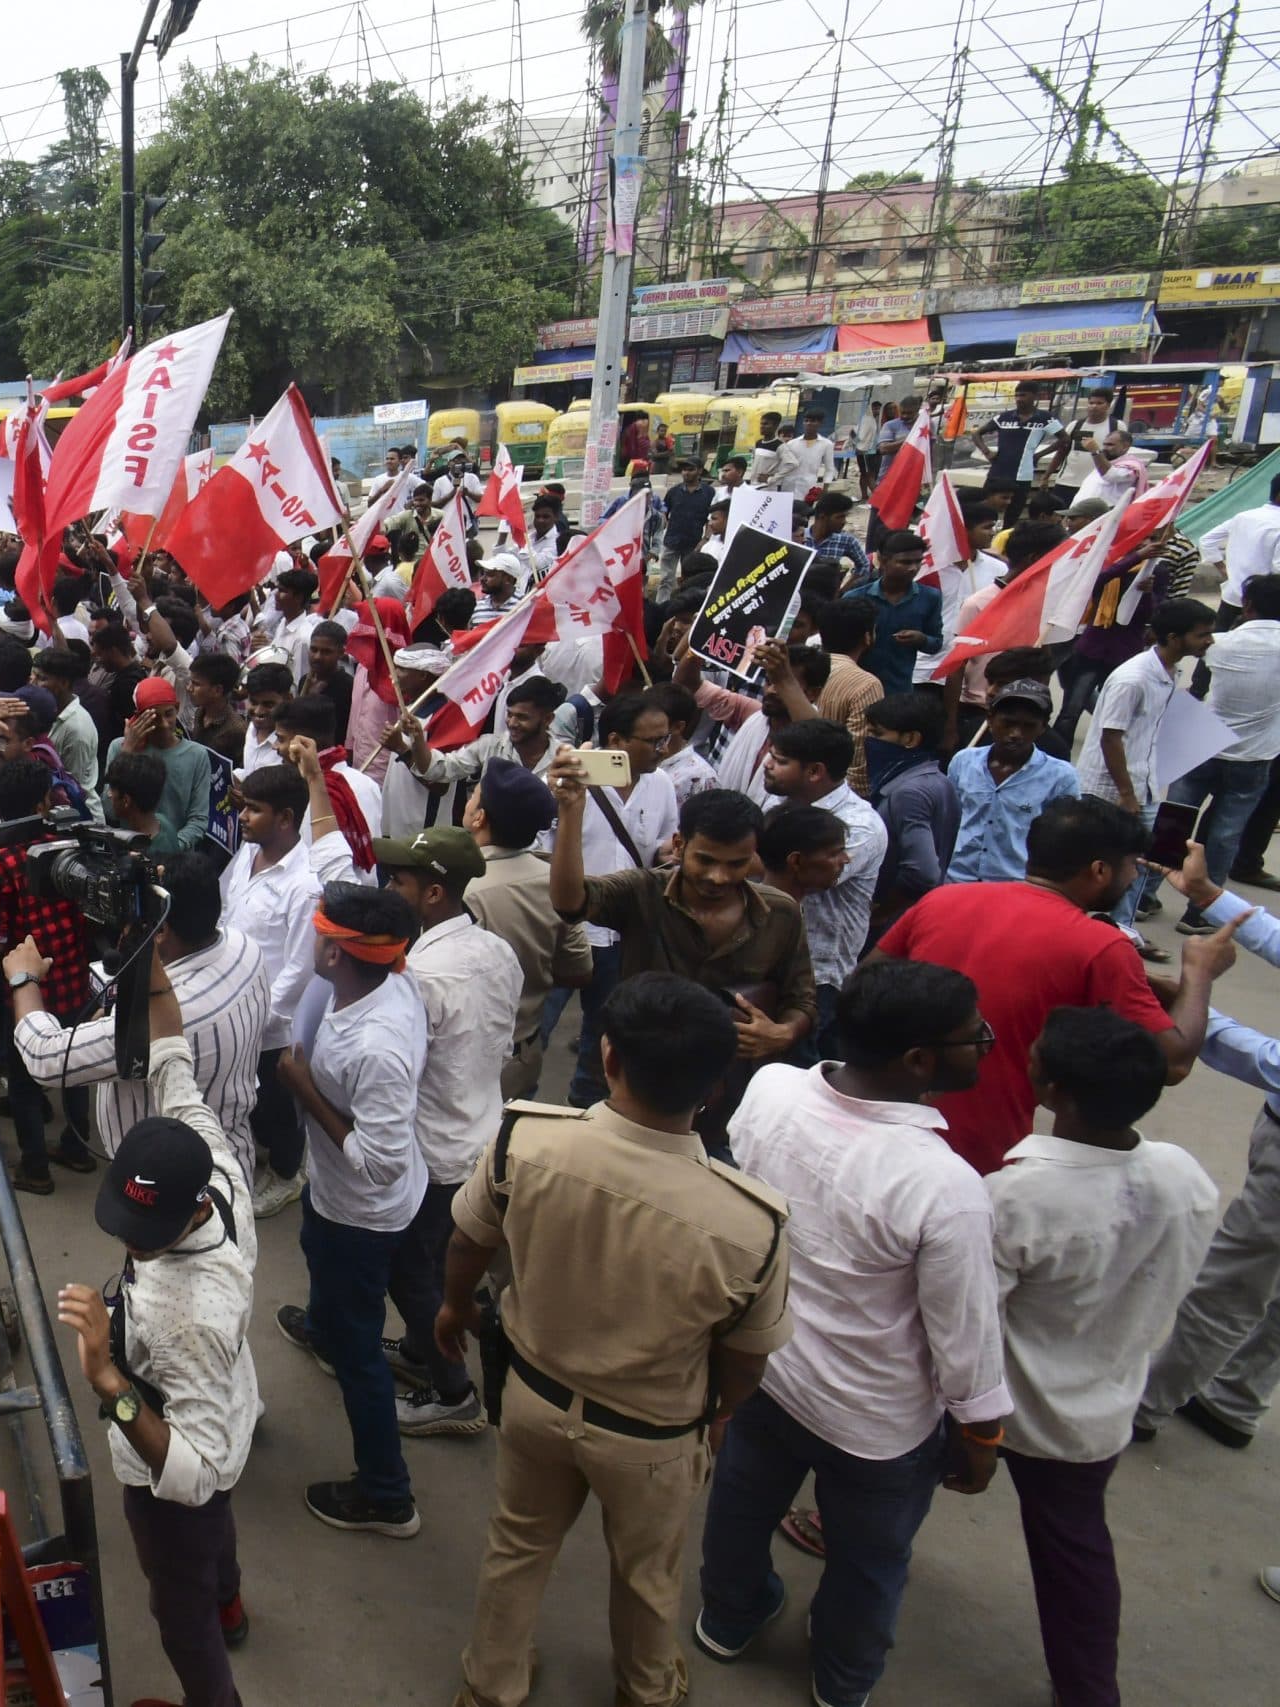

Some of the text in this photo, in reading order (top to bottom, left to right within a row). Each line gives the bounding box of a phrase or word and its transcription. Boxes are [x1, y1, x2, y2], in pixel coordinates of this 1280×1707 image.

[1213, 271, 1259, 284] MAK
[705, 603, 718, 618] KG
[725, 587, 737, 601] PG
[701, 632, 746, 664] AISF
